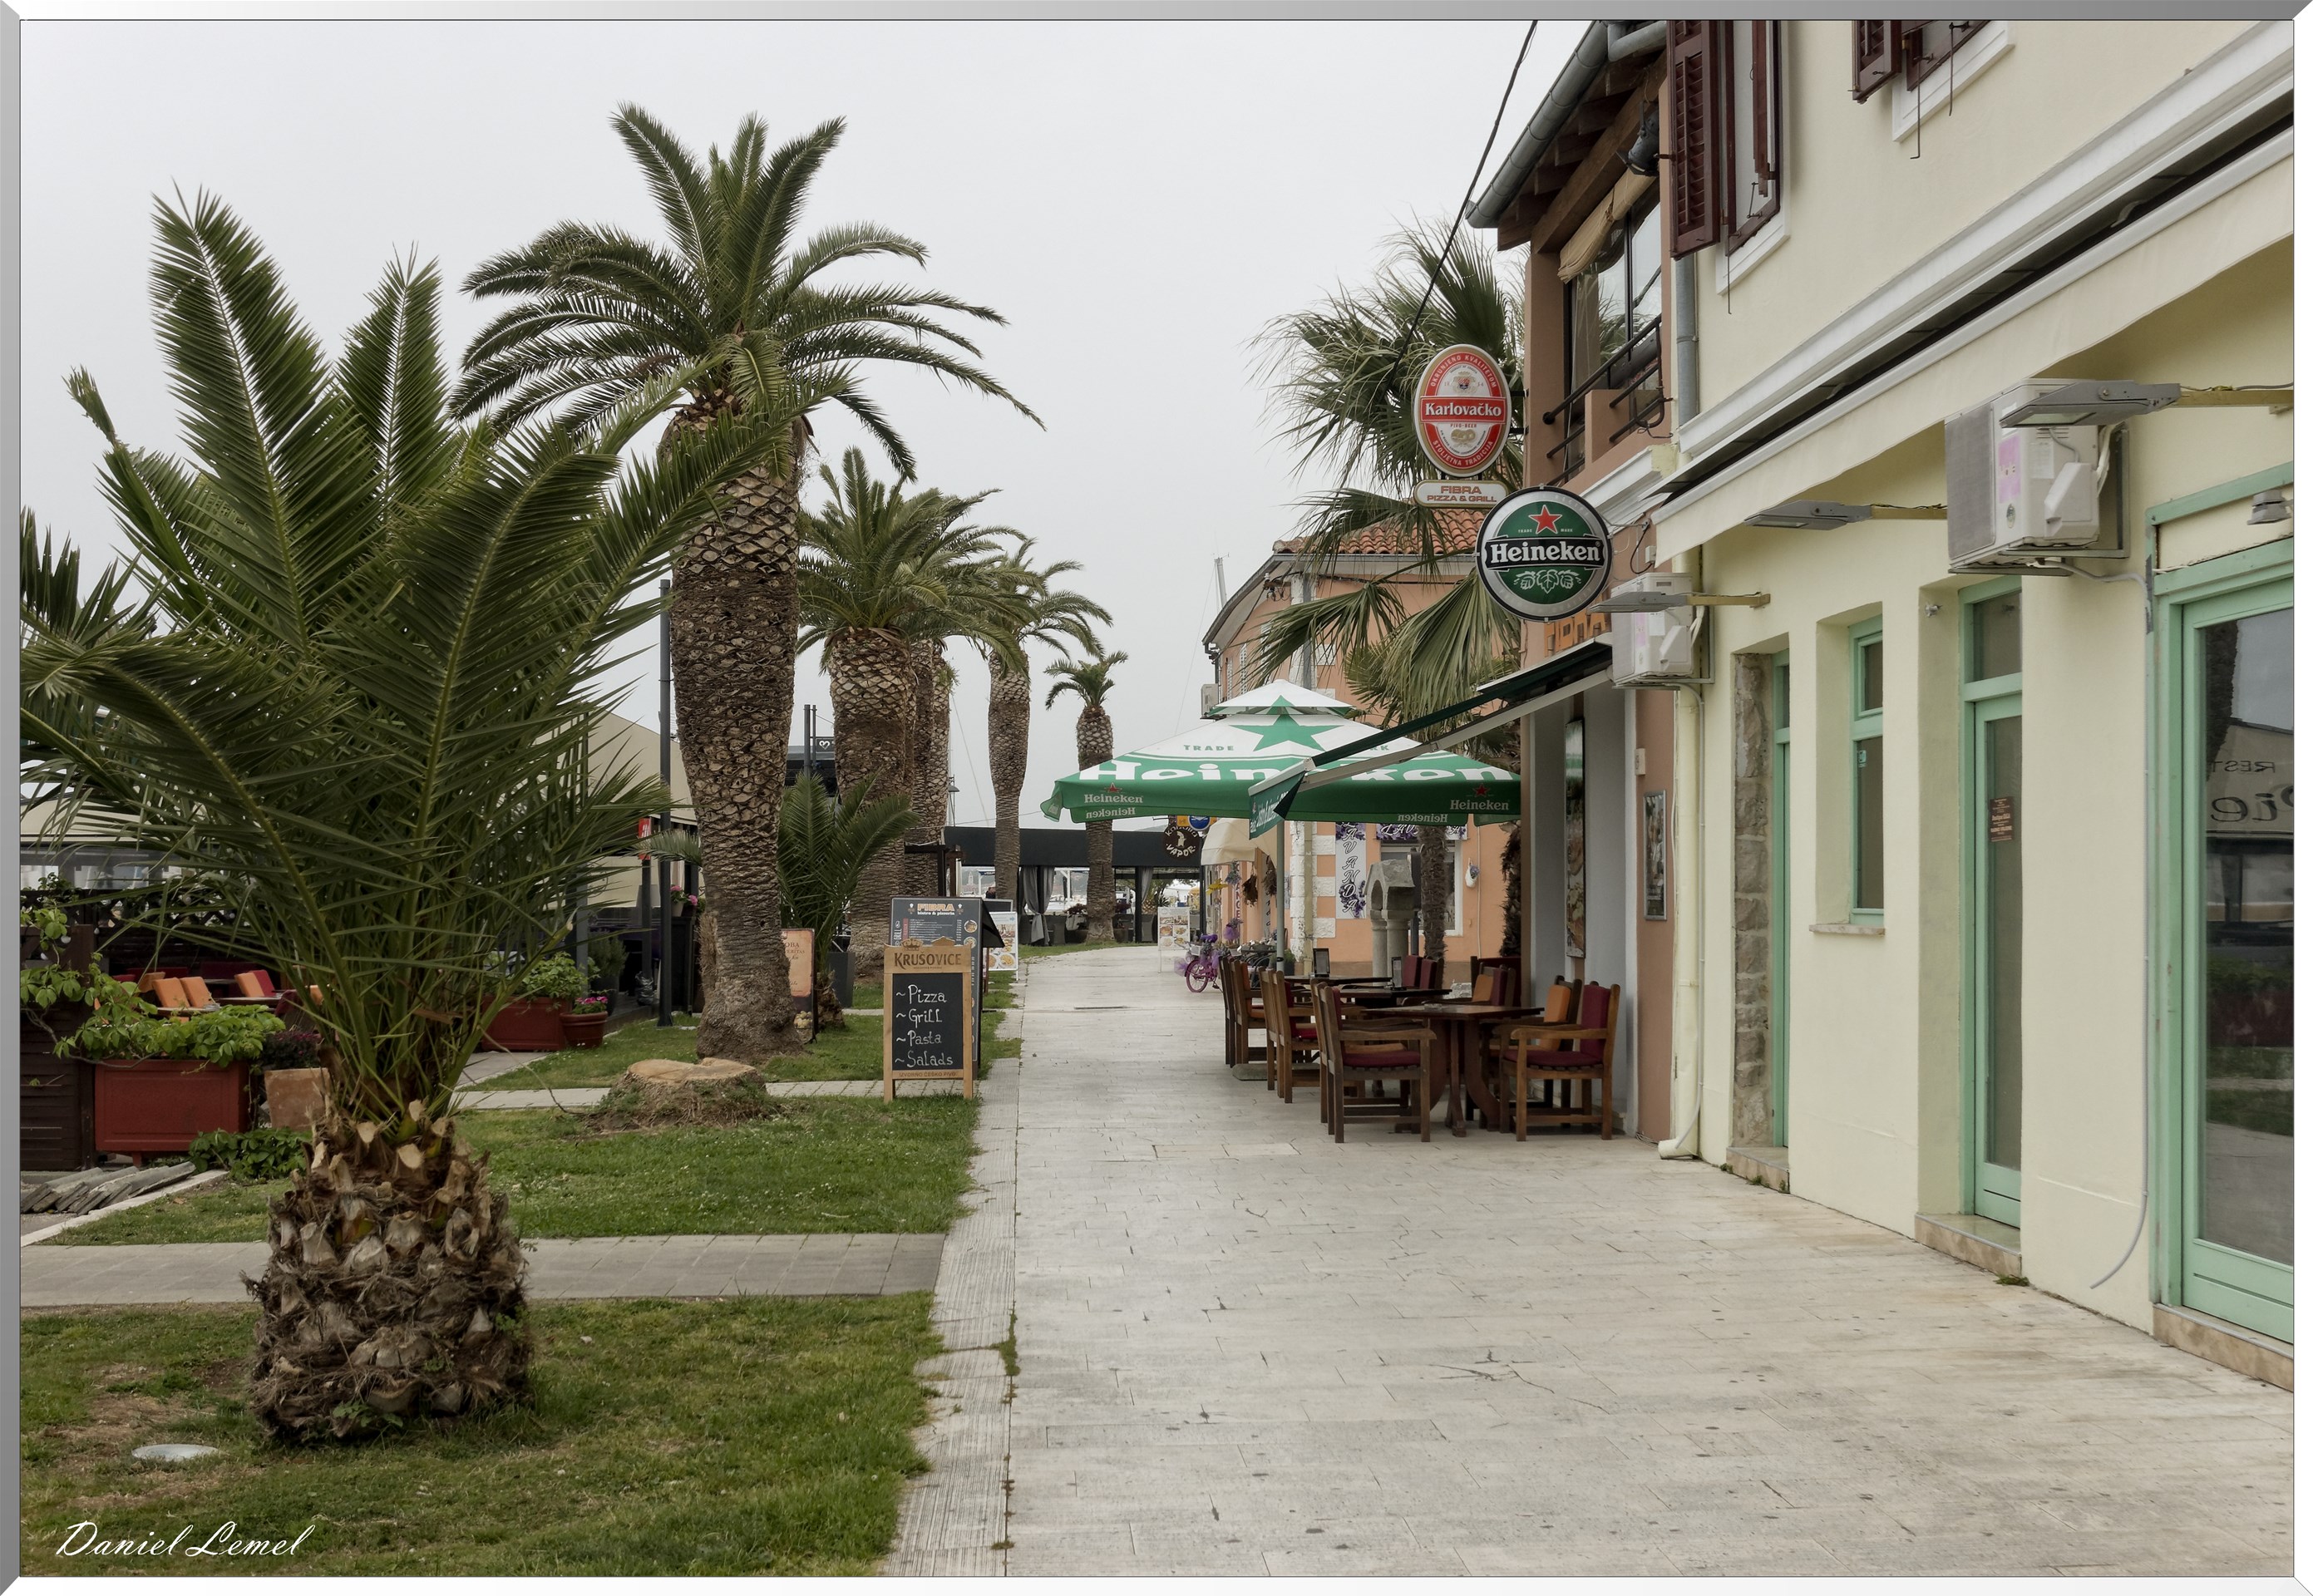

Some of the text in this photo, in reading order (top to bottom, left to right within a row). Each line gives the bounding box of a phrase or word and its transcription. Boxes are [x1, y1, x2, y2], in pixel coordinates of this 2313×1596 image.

[1464, 355, 1497, 388] KVALITETOM
[1425, 402, 1502, 416] Karlovačko
[1433, 440, 1462, 466] STOLJETNA
[1465, 440, 1493, 466] TRADICIJA
[1440, 485, 1482, 495] FIBRA
[1490, 541, 1600, 564] Heineken
[1083, 794, 1144, 804] Heineken
[1450, 800, 1509, 811] Heineken
[917, 903, 955, 912] FIBRA
[894, 951, 962, 970] KRUŠOVICE
[907, 984, 948, 1004] Pizza
[907, 1029, 942, 1047] Pasta
[906, 1050, 954, 1068] Salads
